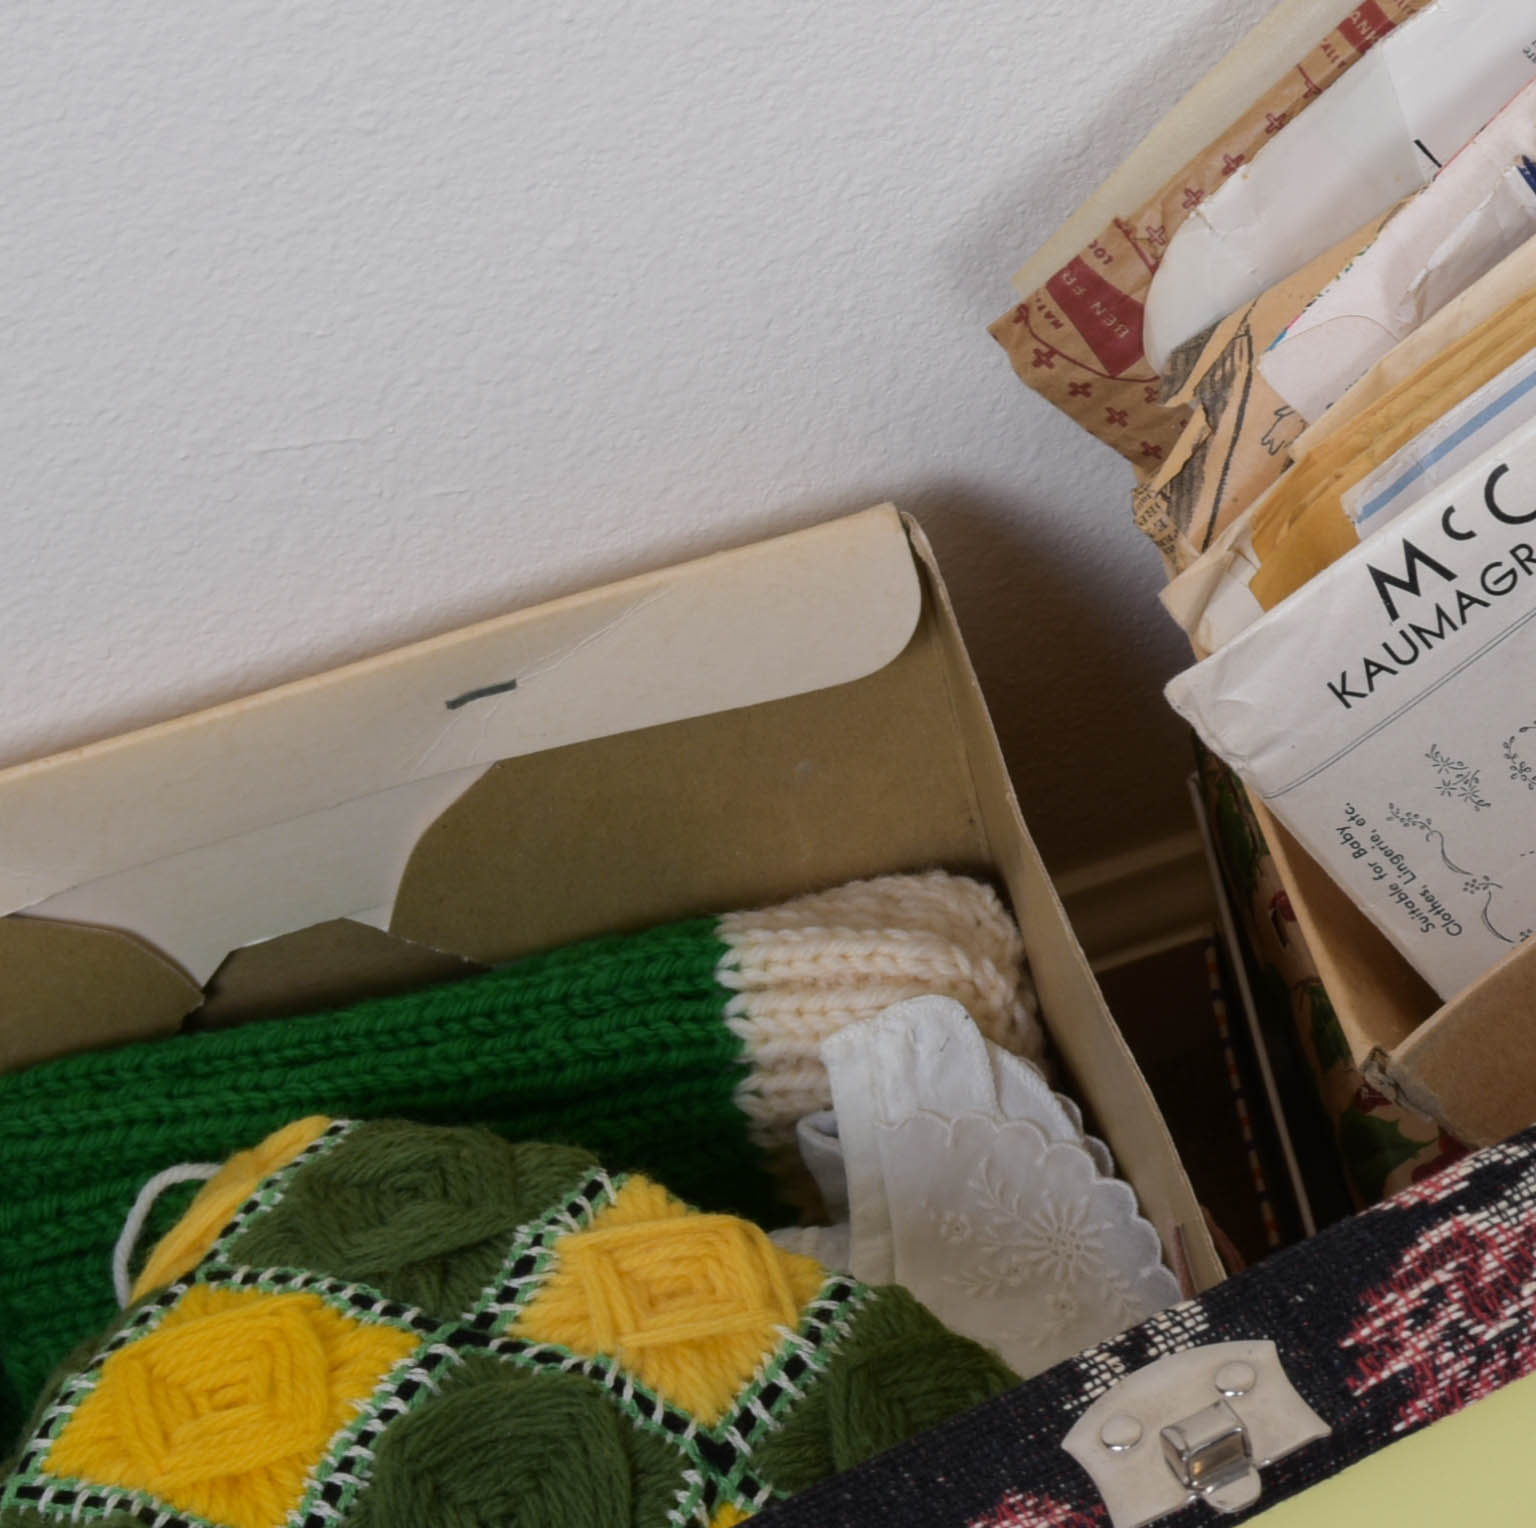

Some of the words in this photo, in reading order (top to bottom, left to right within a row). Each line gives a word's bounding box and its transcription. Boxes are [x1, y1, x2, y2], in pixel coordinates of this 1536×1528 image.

[1344, 802, 1367, 828] etc.
[1336, 826, 1368, 859] Baby
[1369, 828, 1417, 886] Lingerie,
[1367, 861, 1388, 881] for
[1389, 882, 1436, 933] Suitable
[1418, 884, 1464, 937] Clothes,
